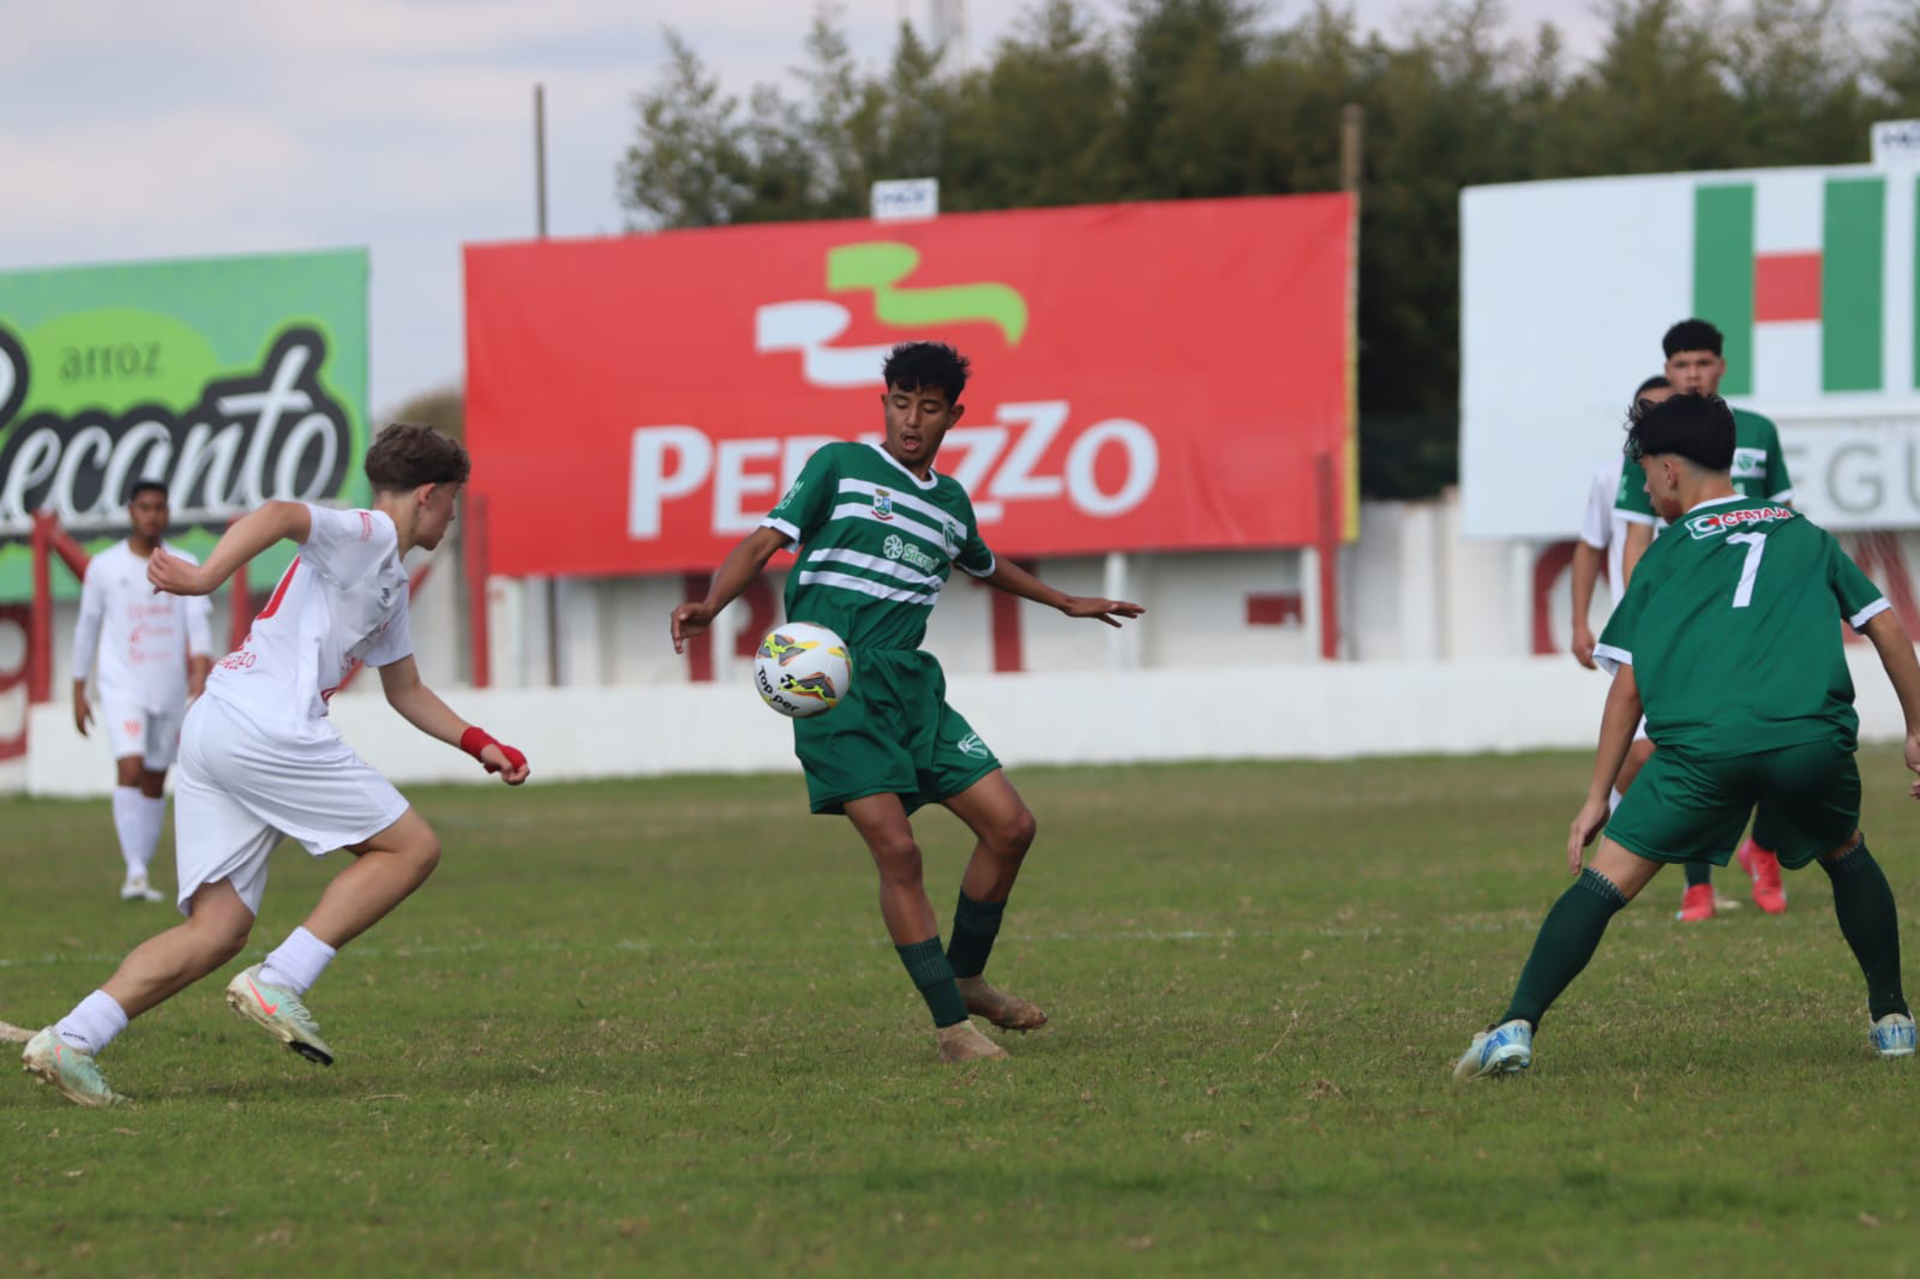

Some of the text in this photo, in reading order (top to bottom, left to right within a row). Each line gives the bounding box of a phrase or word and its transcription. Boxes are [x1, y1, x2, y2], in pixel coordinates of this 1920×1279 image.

[60, 343, 163, 382] arroz
[0, 345, 338, 517] ecanto
[627, 399, 1160, 542] PEZZO
[1725, 531, 1768, 608] 7
